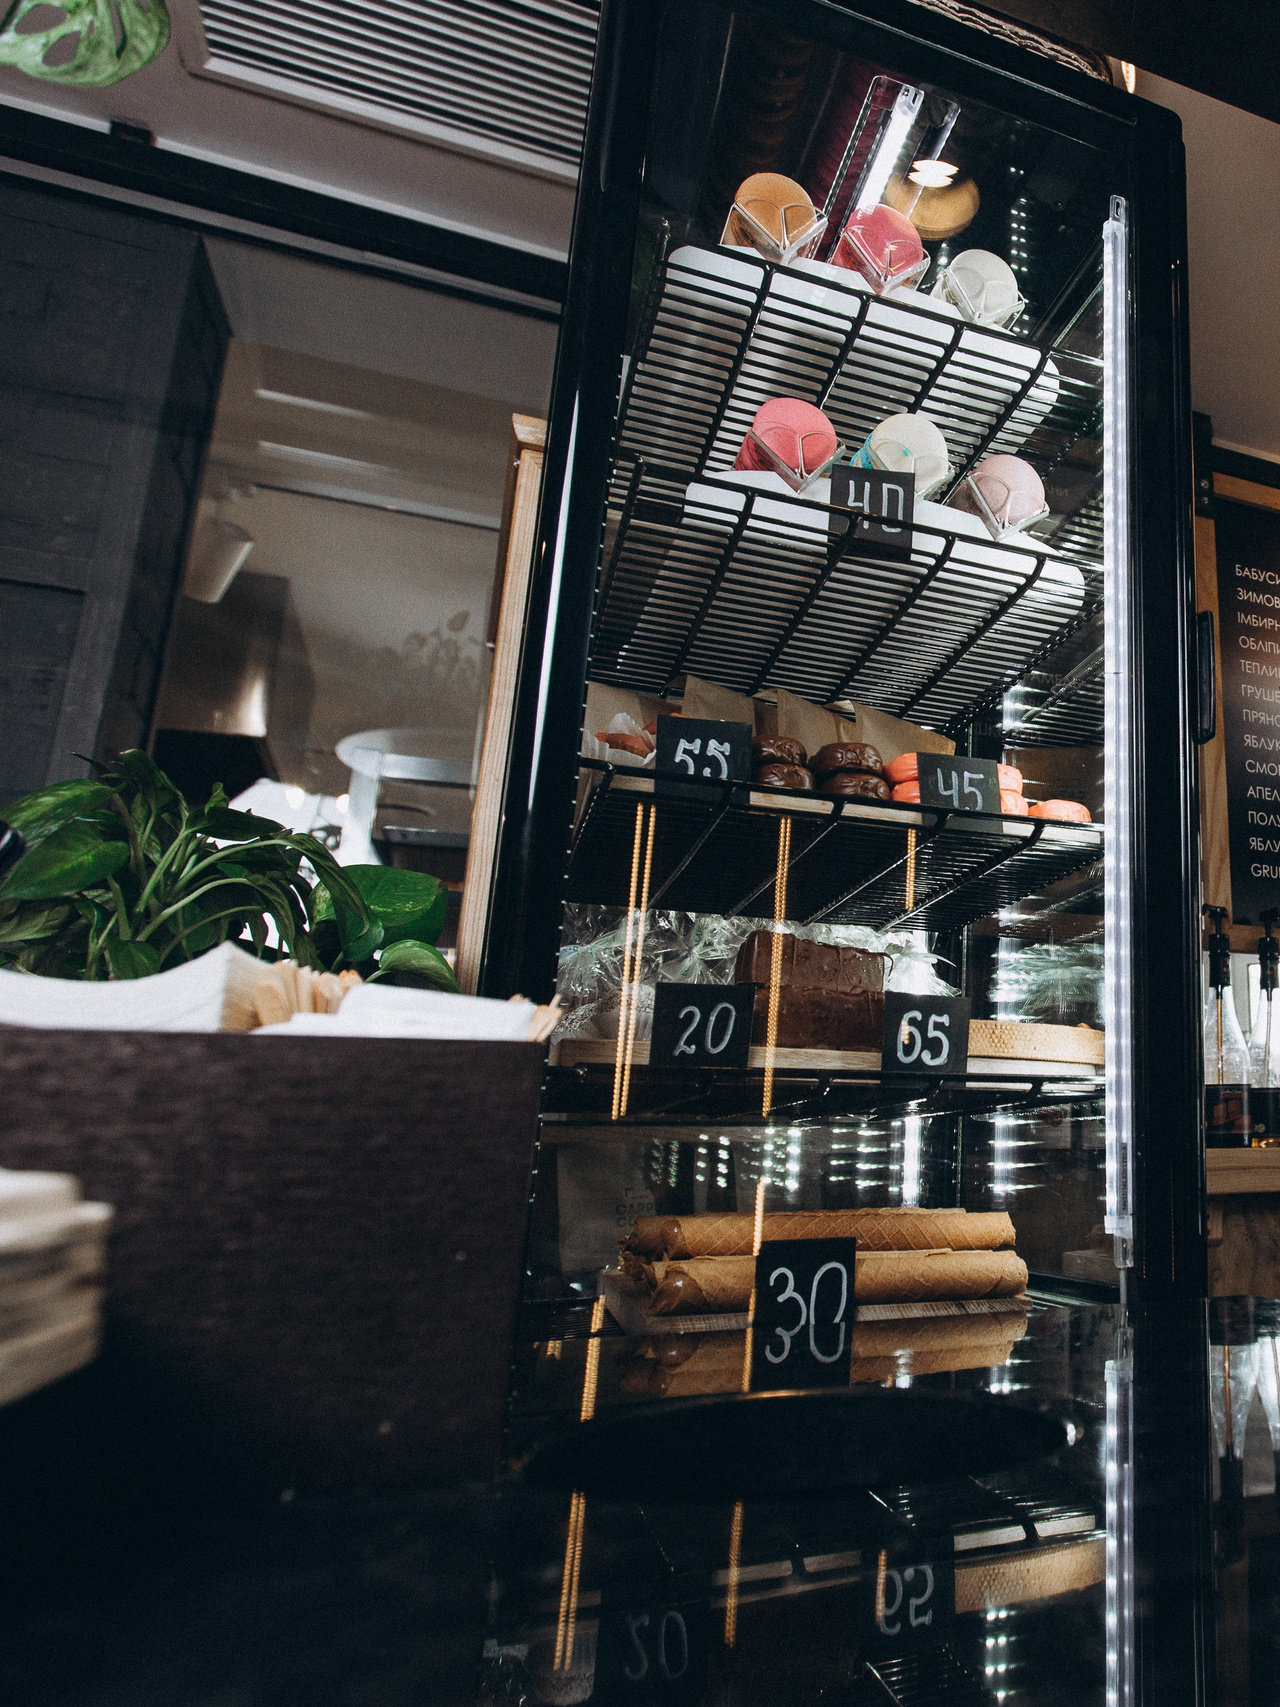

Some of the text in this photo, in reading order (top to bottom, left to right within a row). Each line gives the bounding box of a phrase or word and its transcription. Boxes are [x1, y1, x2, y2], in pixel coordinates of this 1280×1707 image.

[847, 479, 904, 533] 40
[674, 738, 731, 779] 55
[937, 768, 985, 812] 45
[672, 1002, 737, 1057] 20
[896, 1010, 950, 1067] 65
[765, 1261, 848, 1364] 30
